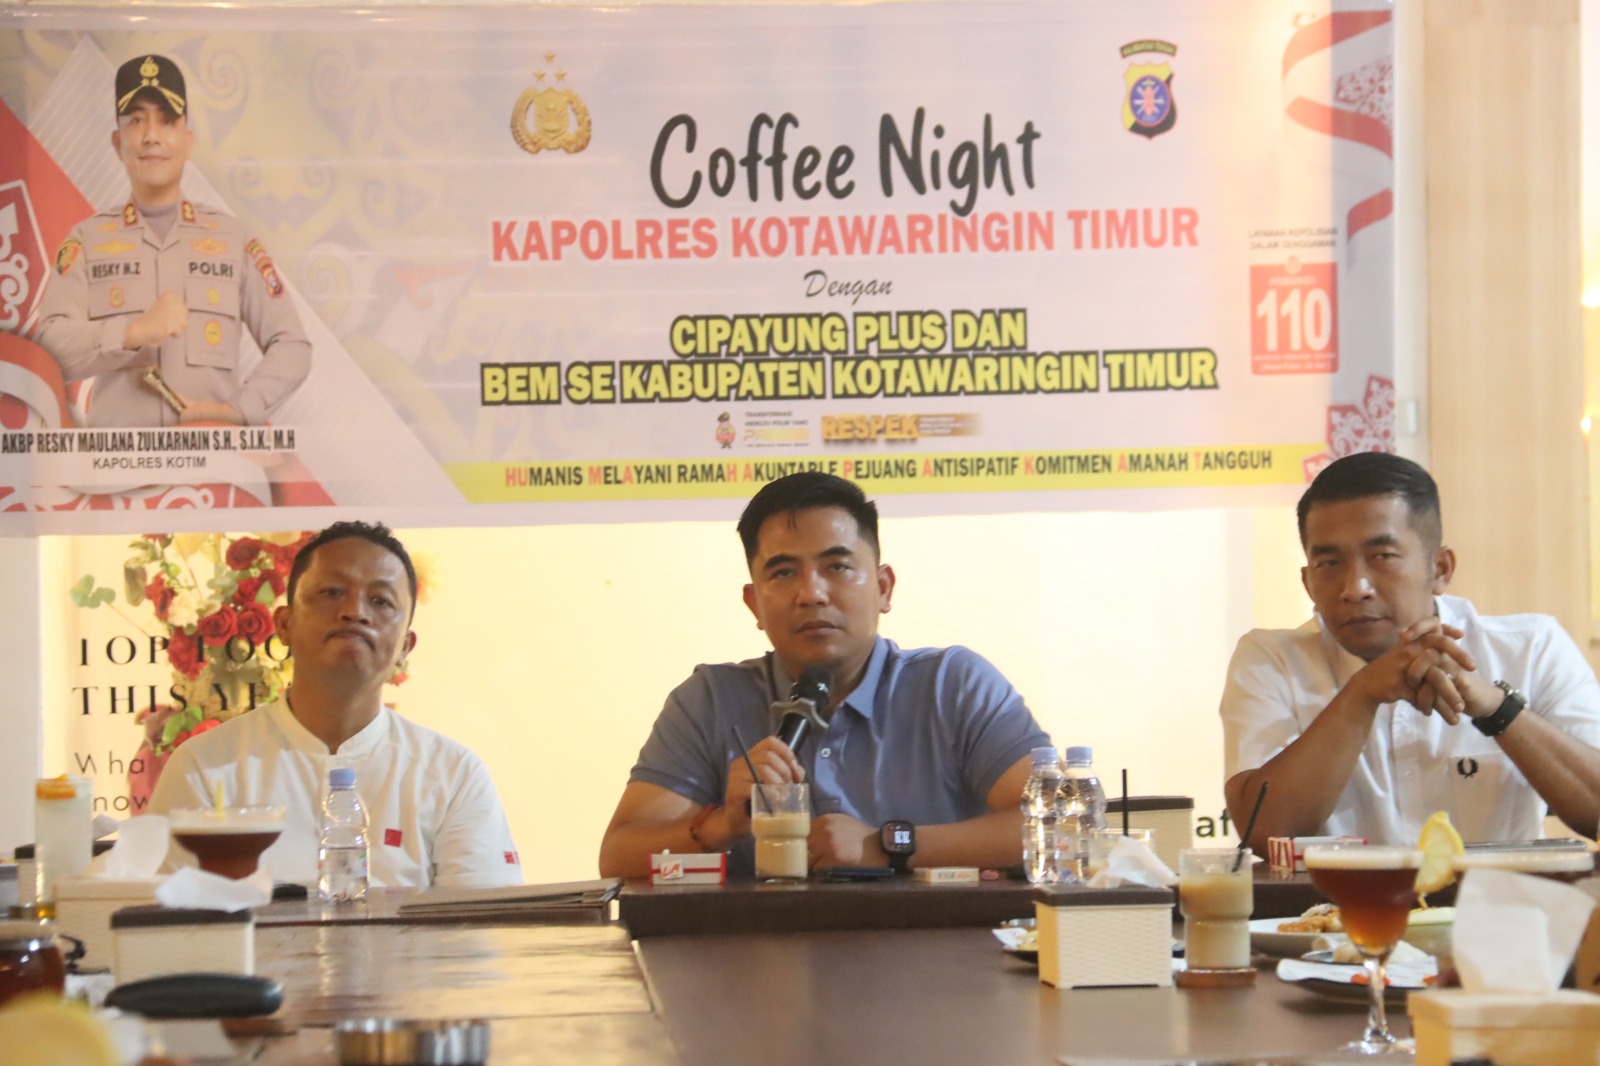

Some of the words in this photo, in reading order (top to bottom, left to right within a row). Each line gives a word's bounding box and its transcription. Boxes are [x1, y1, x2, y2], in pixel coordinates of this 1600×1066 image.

[650, 112, 856, 208] Coffee
[879, 107, 1041, 216] Night
[491, 217, 719, 262] KAPOLRES
[731, 210, 1056, 257] KOTAWARINGIN
[1067, 207, 1199, 251] TIMUR
[92, 263, 120, 278] RESKY
[188, 262, 233, 278] POLRI
[804, 270, 893, 306] Dengan
[670, 313, 849, 358] CIPAYUNG
[853, 310, 947, 353] PLUS
[952, 308, 1027, 350] DAN
[1256, 287, 1332, 352] 110
[481, 364, 561, 406] BEM
[564, 361, 615, 404] SE
[619, 358, 826, 402] KABUPATEN
[832, 352, 1099, 398] KOTAWARINGIN
[1104, 347, 1219, 390] TIMUR
[1, 432, 33, 453] AKBP
[37, 432, 75, 453] RESKY
[78, 431, 135, 453] MAULANA
[137, 430, 209, 452] ZULKARNAIN
[273, 429, 295, 450] M.H
[822, 414, 919, 440] RESPEK
[93, 457, 162, 470] KAPOLRES
[166, 456, 206, 469] KOTIM
[505, 465, 583, 487] HUMANIS
[588, 463, 672, 486] MELAYANI
[677, 462, 738, 483] RAMAH
[843, 459, 917, 480] PEJUANG
[922, 457, 1019, 478] ANTISIPATIF
[1024, 454, 1112, 475] KOMITMEN
[1117, 452, 1189, 473] AMANAH
[1194, 450, 1272, 471] TANGGUH
[72, 683, 187, 716] THIS
